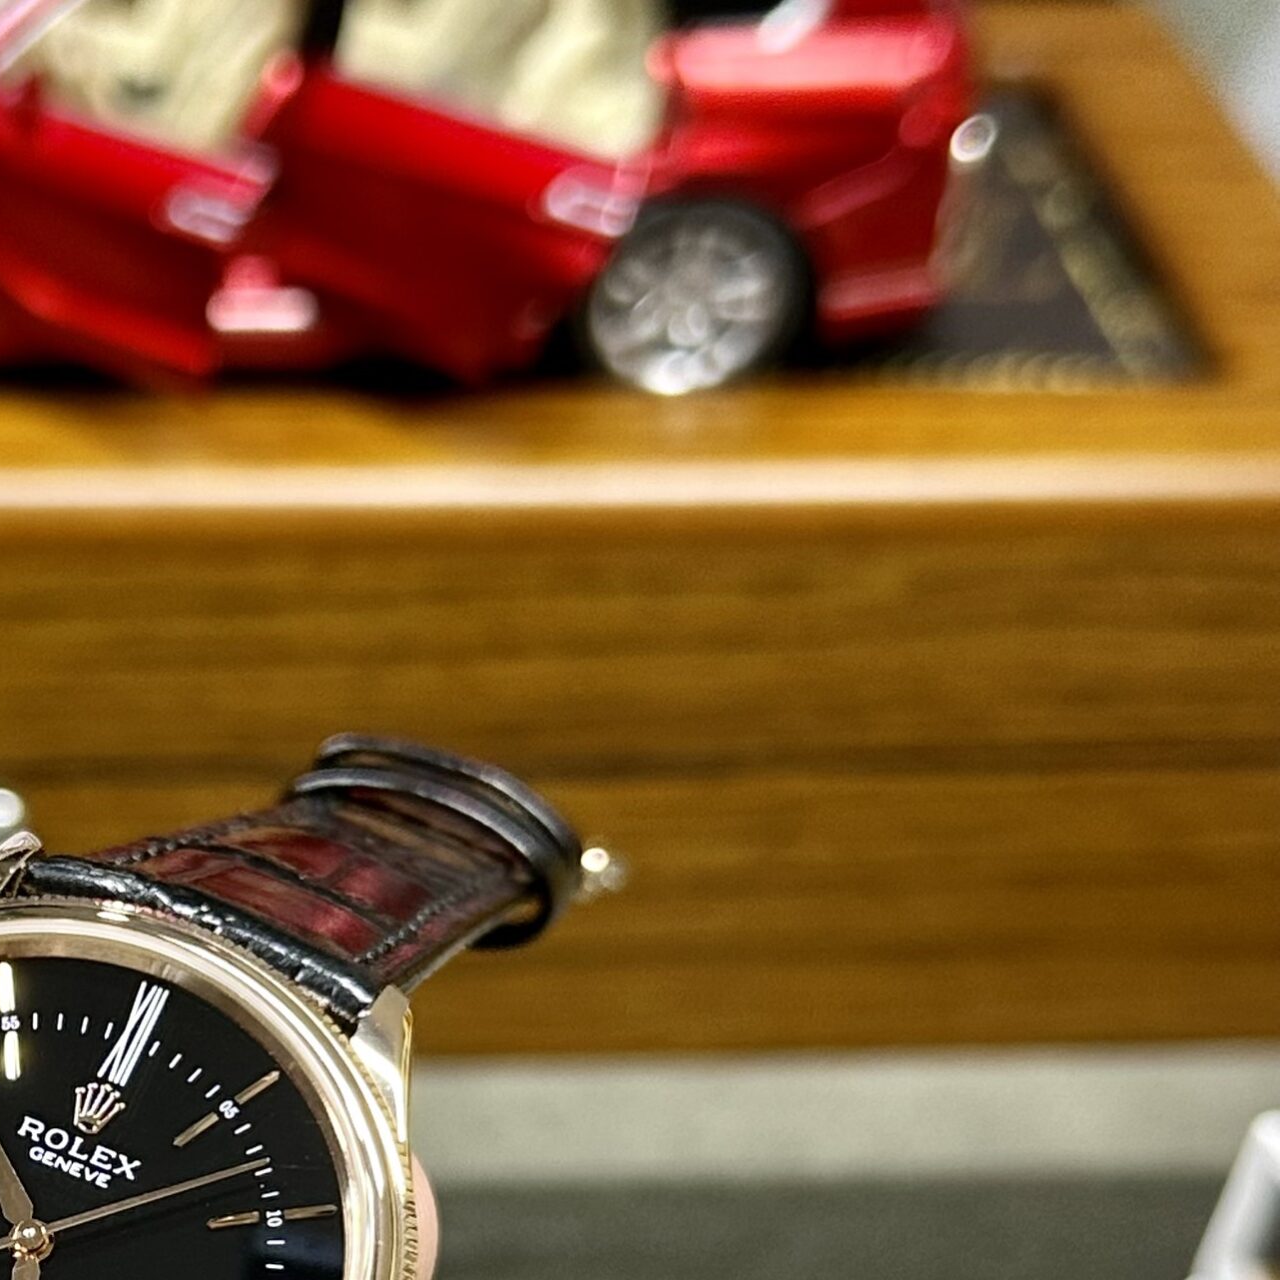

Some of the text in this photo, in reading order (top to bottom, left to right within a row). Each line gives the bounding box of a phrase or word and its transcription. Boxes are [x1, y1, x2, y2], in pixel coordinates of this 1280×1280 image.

[0, 1015, 20, 1031] 55
[219, 1100, 240, 1120] 05
[17, 1115, 142, 1181] ROLEX
[28, 1146, 113, 1190] GENEVE
[265, 1209, 283, 1228] 10
